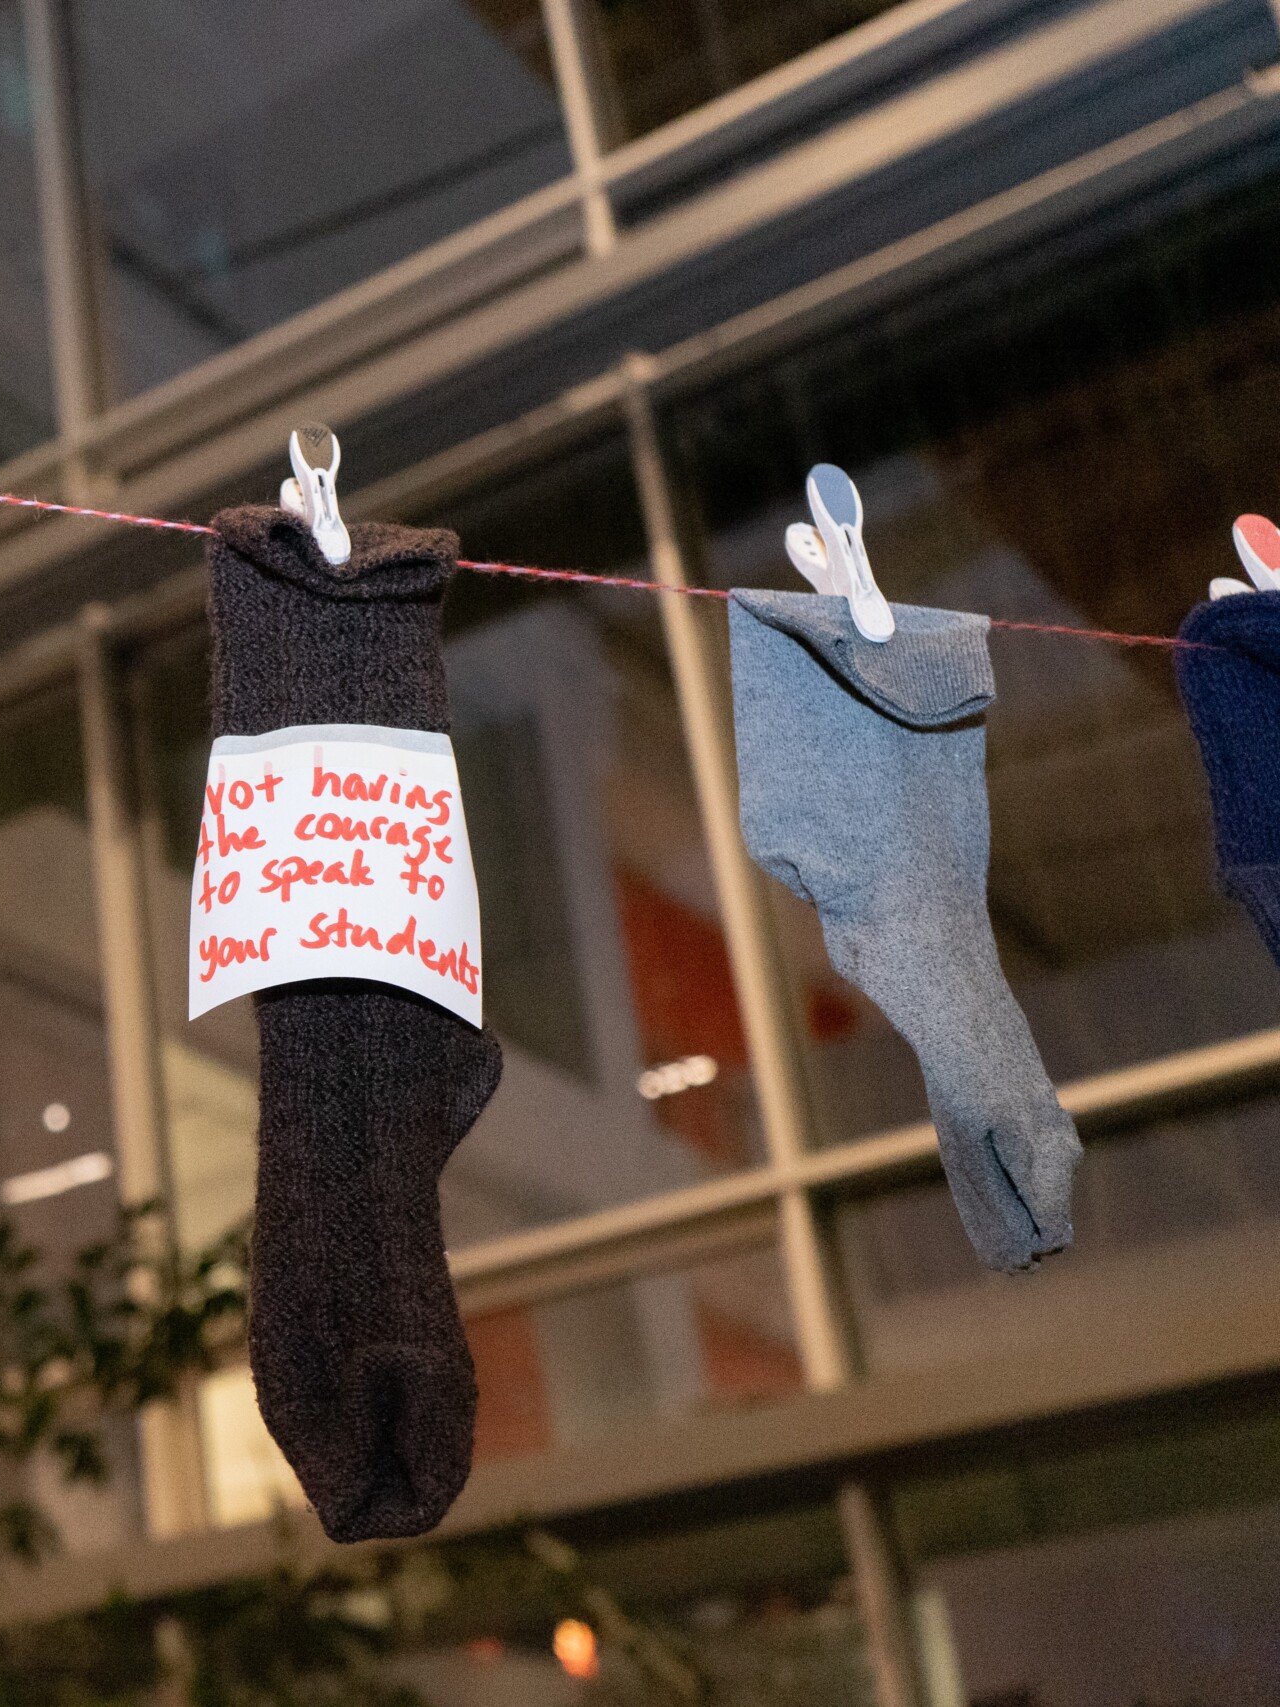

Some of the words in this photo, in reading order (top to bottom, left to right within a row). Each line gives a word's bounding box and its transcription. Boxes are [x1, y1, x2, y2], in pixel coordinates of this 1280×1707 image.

[311, 745, 453, 826] having
[197, 814, 267, 866] the
[294, 812, 454, 866] courage
[198, 870, 241, 914] to
[258, 848, 375, 903] speak
[400, 857, 446, 901] to
[199, 927, 278, 983] your
